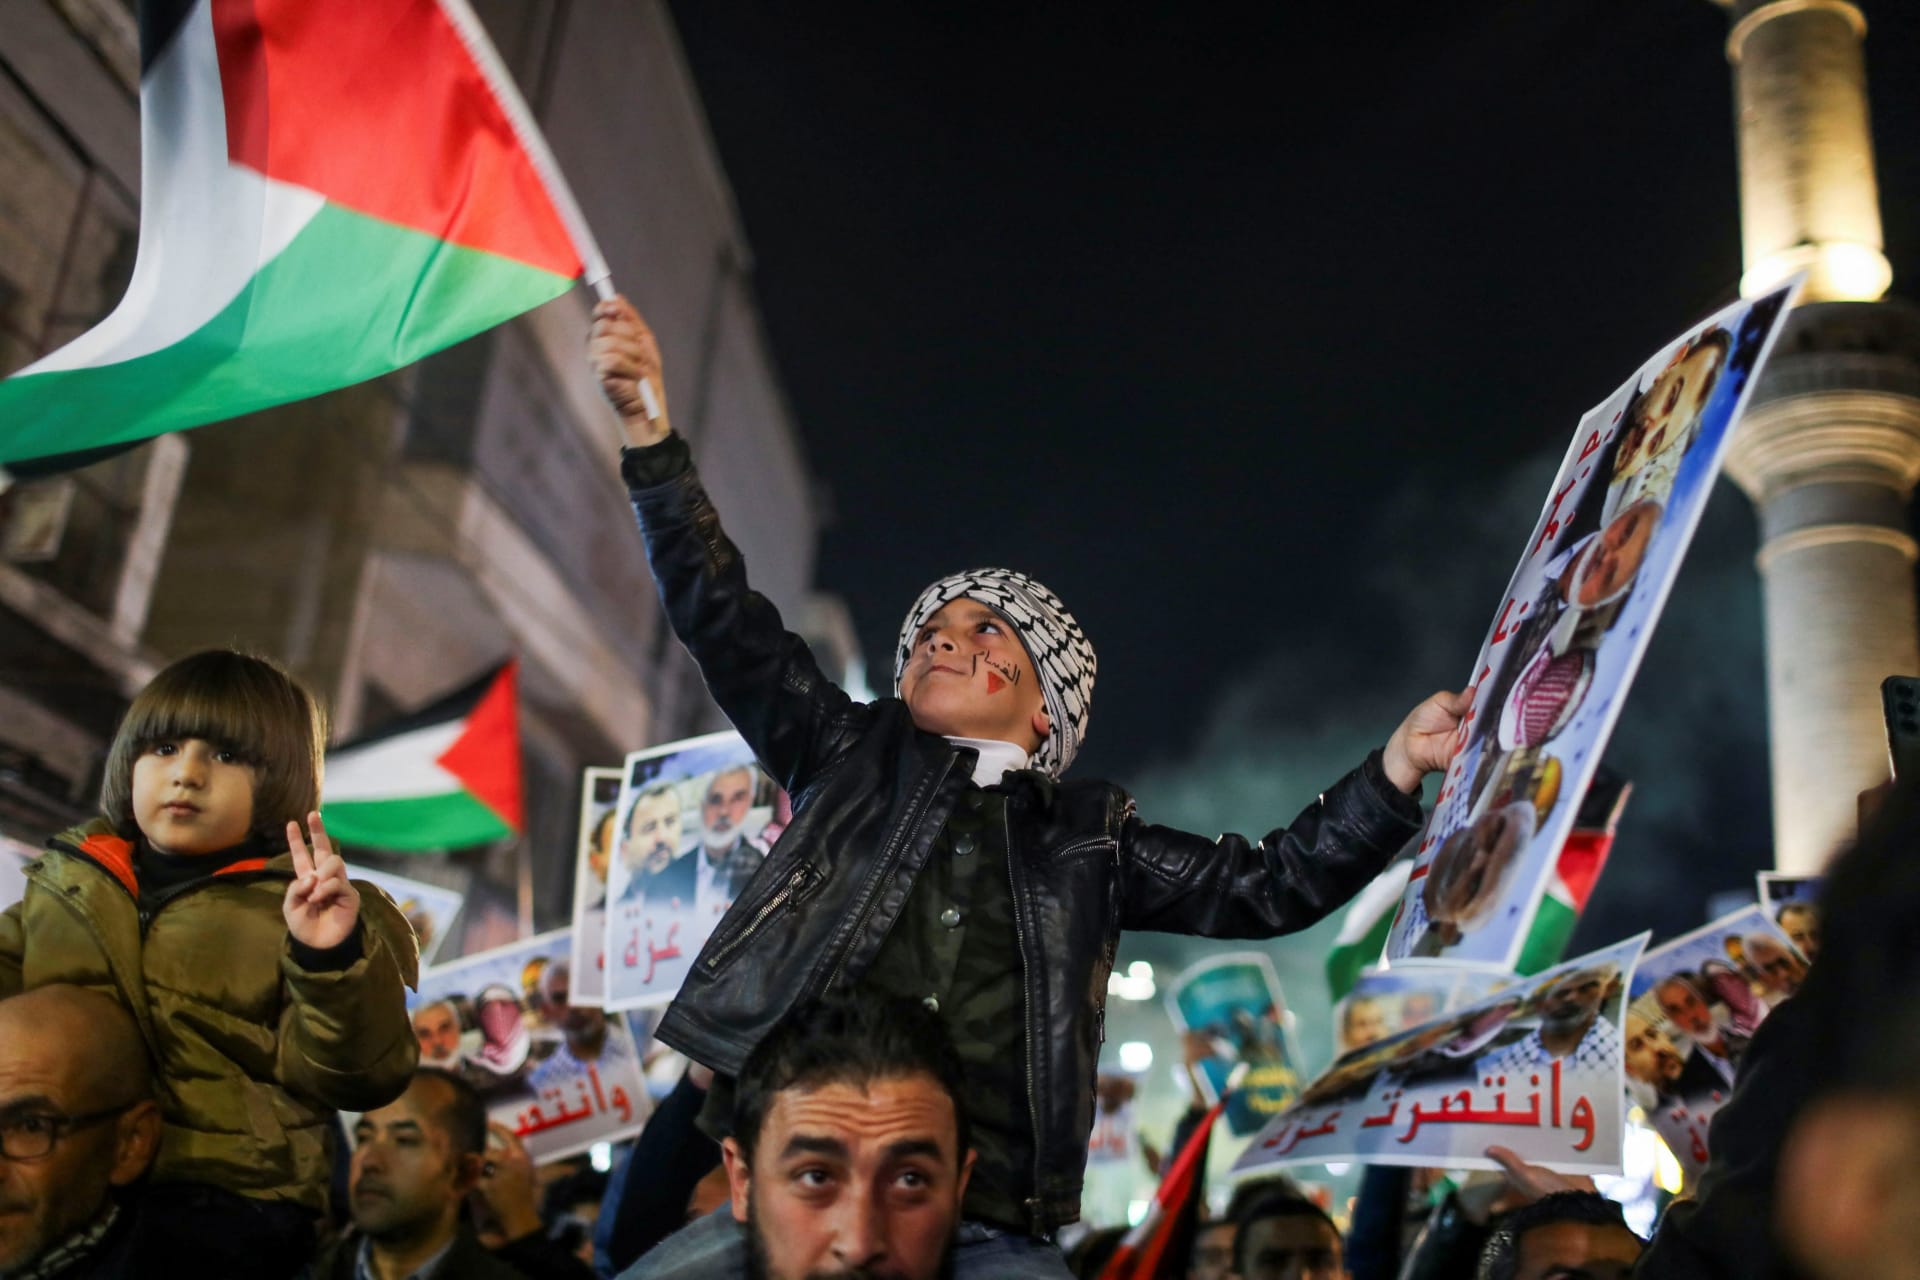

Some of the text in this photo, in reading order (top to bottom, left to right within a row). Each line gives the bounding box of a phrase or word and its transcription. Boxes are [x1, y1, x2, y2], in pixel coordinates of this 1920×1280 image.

[1531, 411, 1622, 557] غزة
[624, 896, 683, 984] غزة
[514, 1062, 633, 1137] وانتص
[1361, 1059, 1596, 1151] وانتصرت
